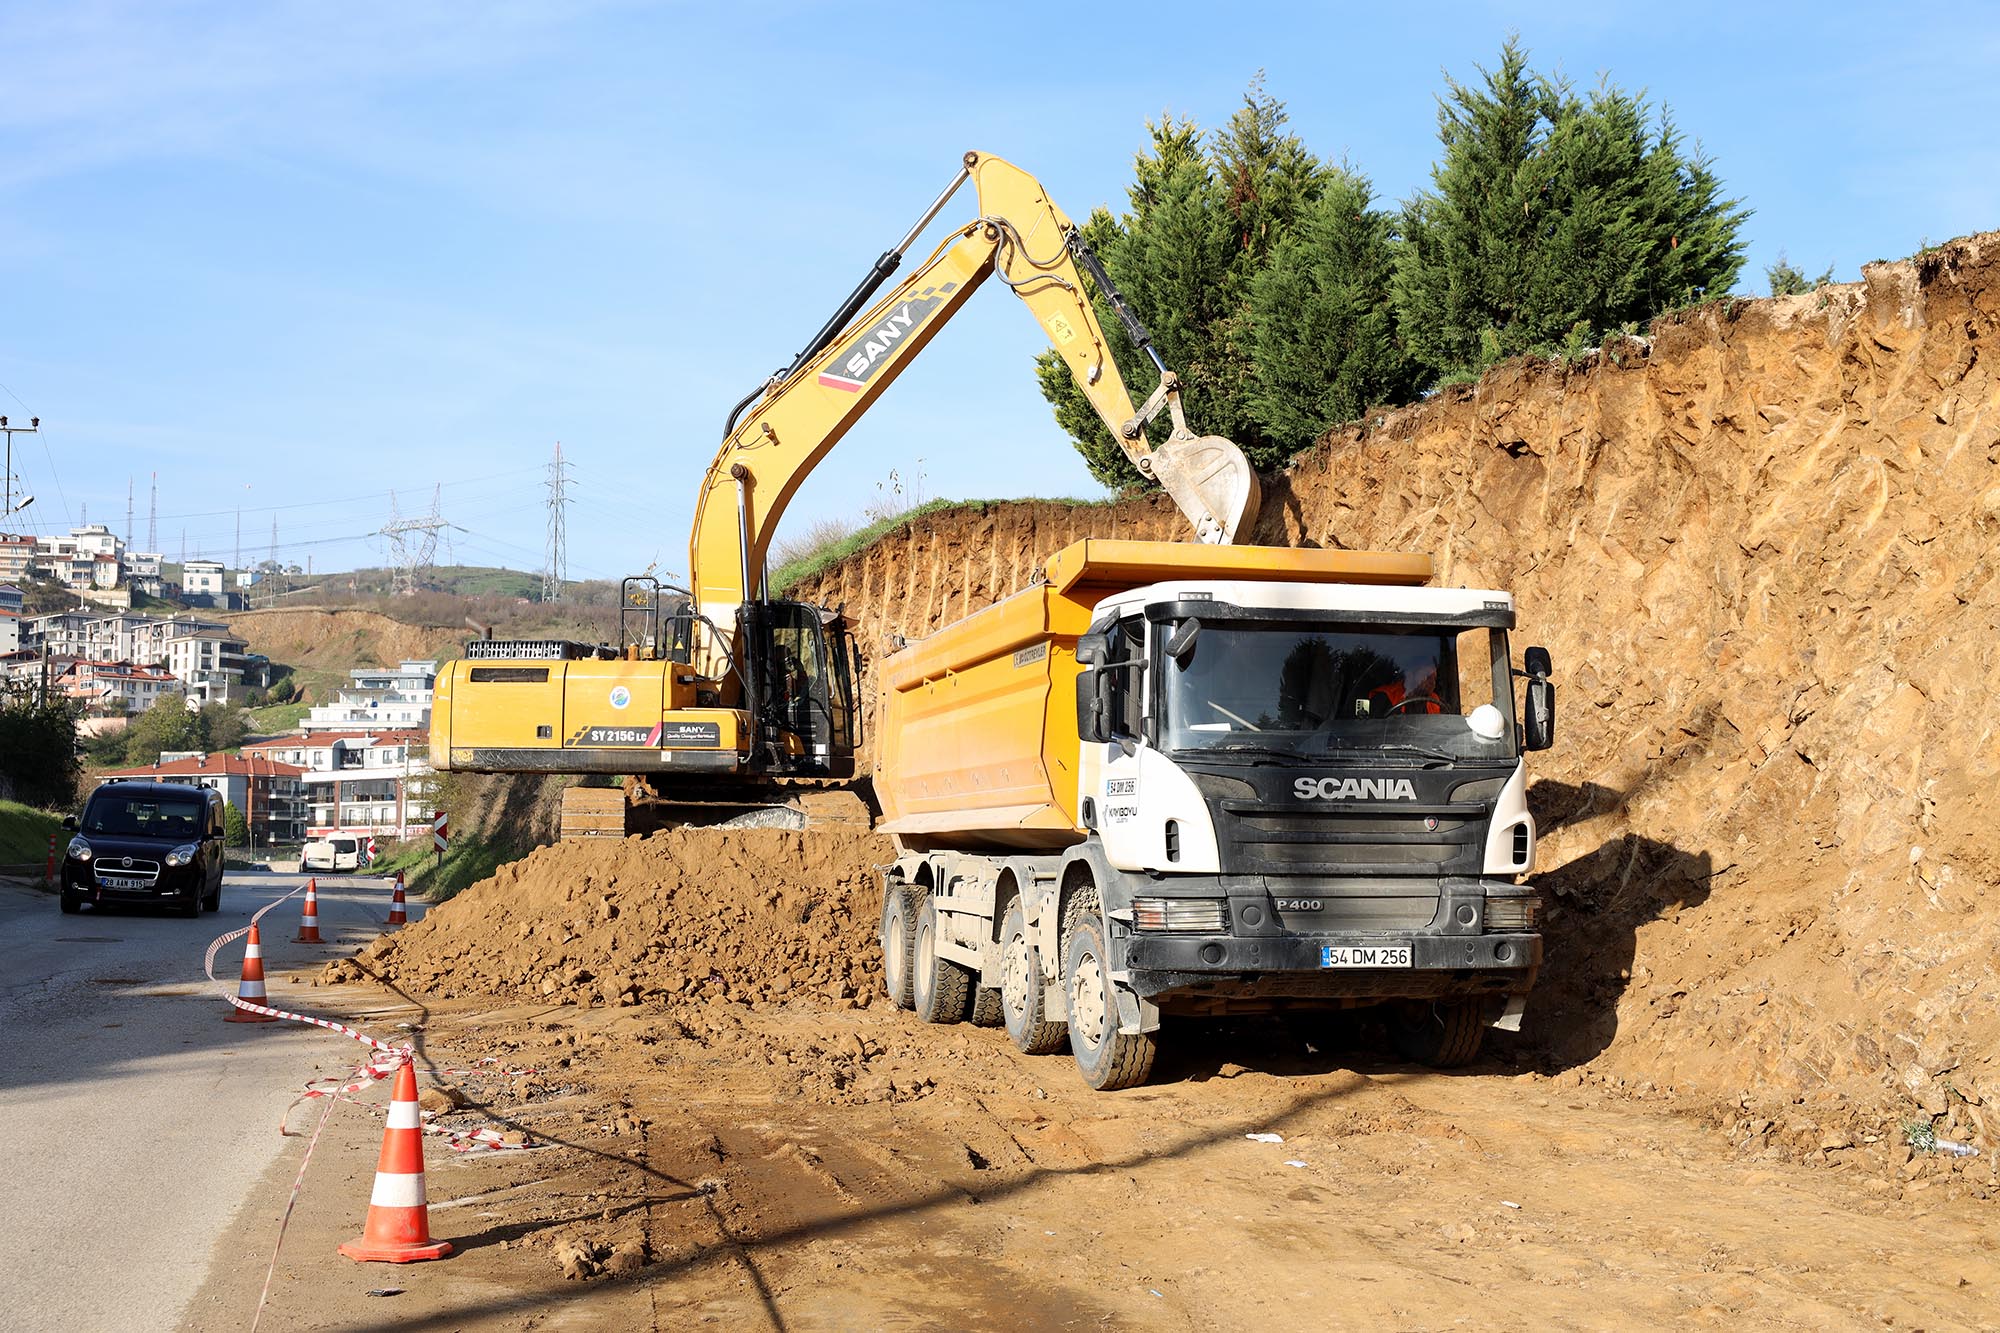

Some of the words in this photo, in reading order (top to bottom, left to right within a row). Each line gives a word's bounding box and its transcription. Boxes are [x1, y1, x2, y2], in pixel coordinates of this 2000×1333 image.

[846, 304, 914, 378] SANY
[591, 730, 606, 742] SY
[608, 730, 635, 741] 215C
[636, 733, 648, 742] LC
[1110, 781, 1116, 793] 54
[1125, 781, 1135, 793] 256
[1293, 777, 1418, 800] SCANIA
[1277, 900, 1287, 911] P
[1289, 900, 1321, 911] 400
[1330, 949, 1348, 964] 54
[1352, 949, 1376, 964] DM
[1380, 949, 1408, 964] 256
